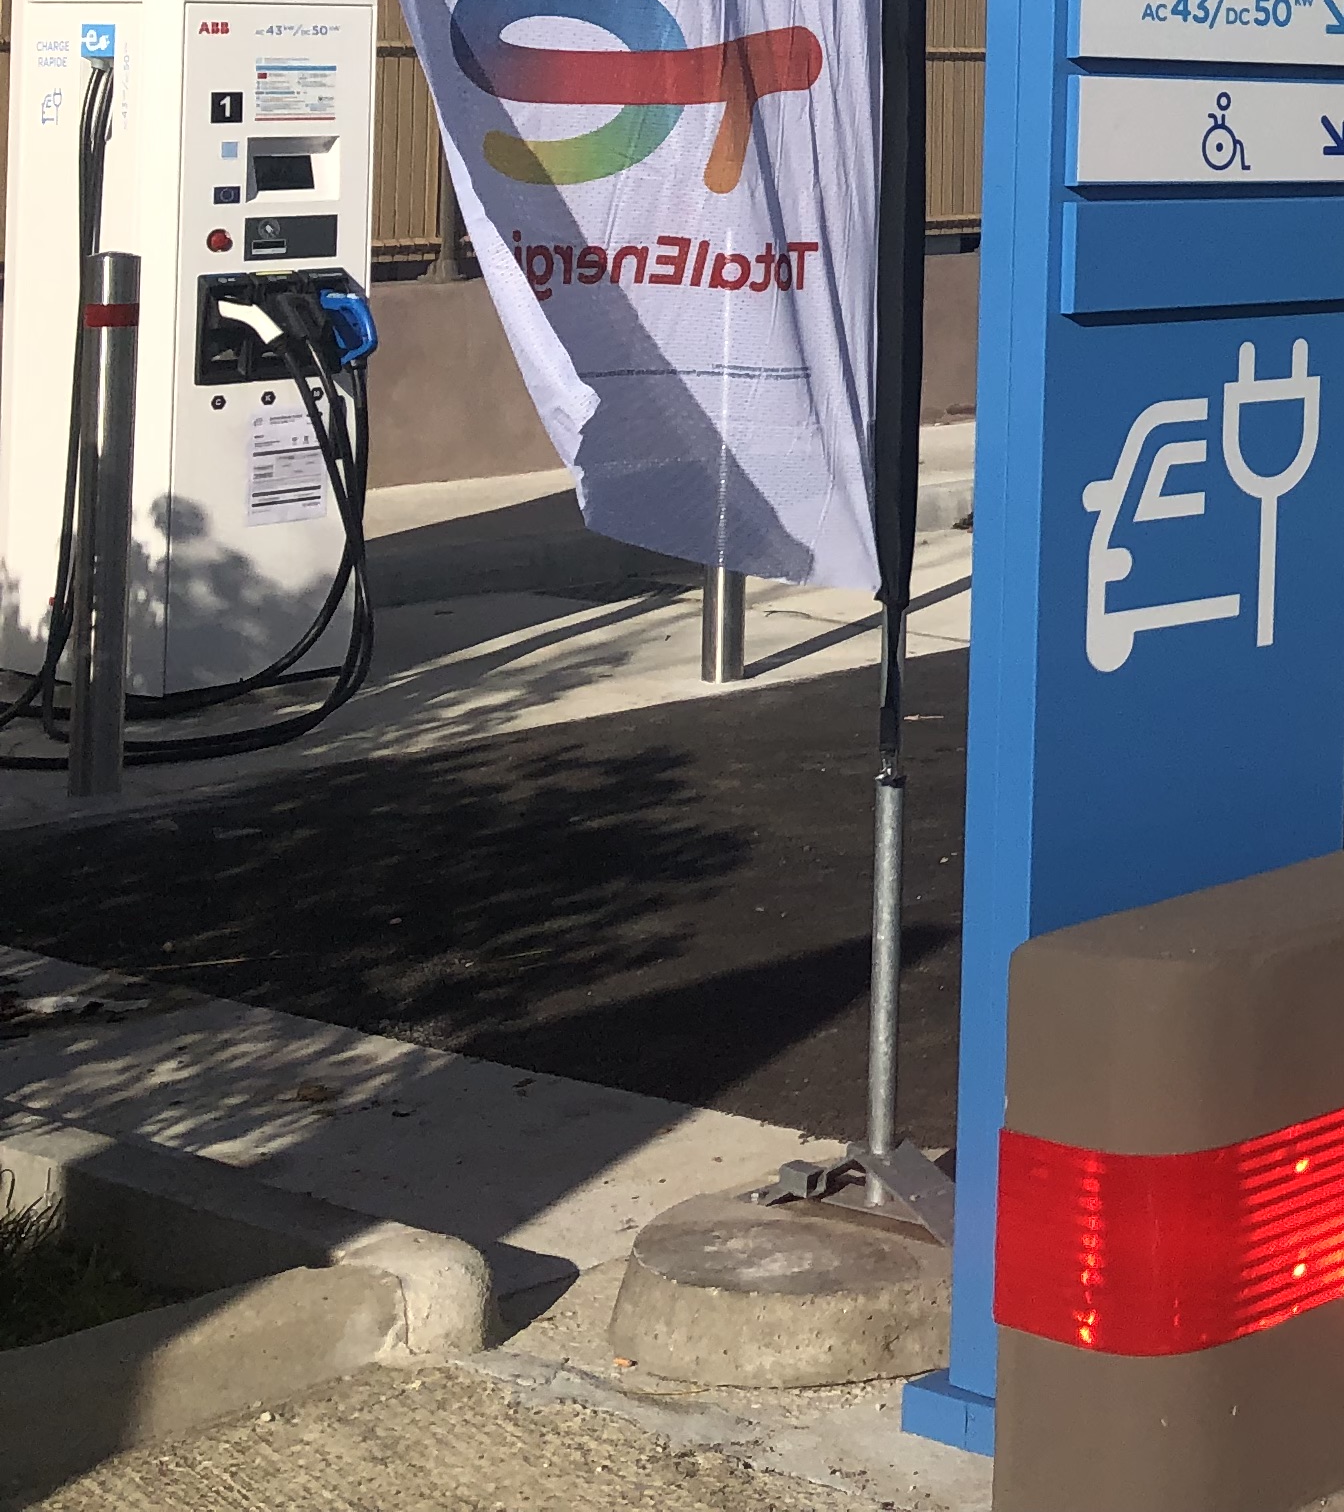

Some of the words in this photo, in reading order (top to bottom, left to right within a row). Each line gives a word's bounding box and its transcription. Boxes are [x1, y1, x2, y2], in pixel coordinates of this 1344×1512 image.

[199, 22, 230, 34] ABB
[36, 41, 70, 51] CHARGE
[38, 57, 67, 67] RAPIDE
[220, 96, 231, 117] 1
